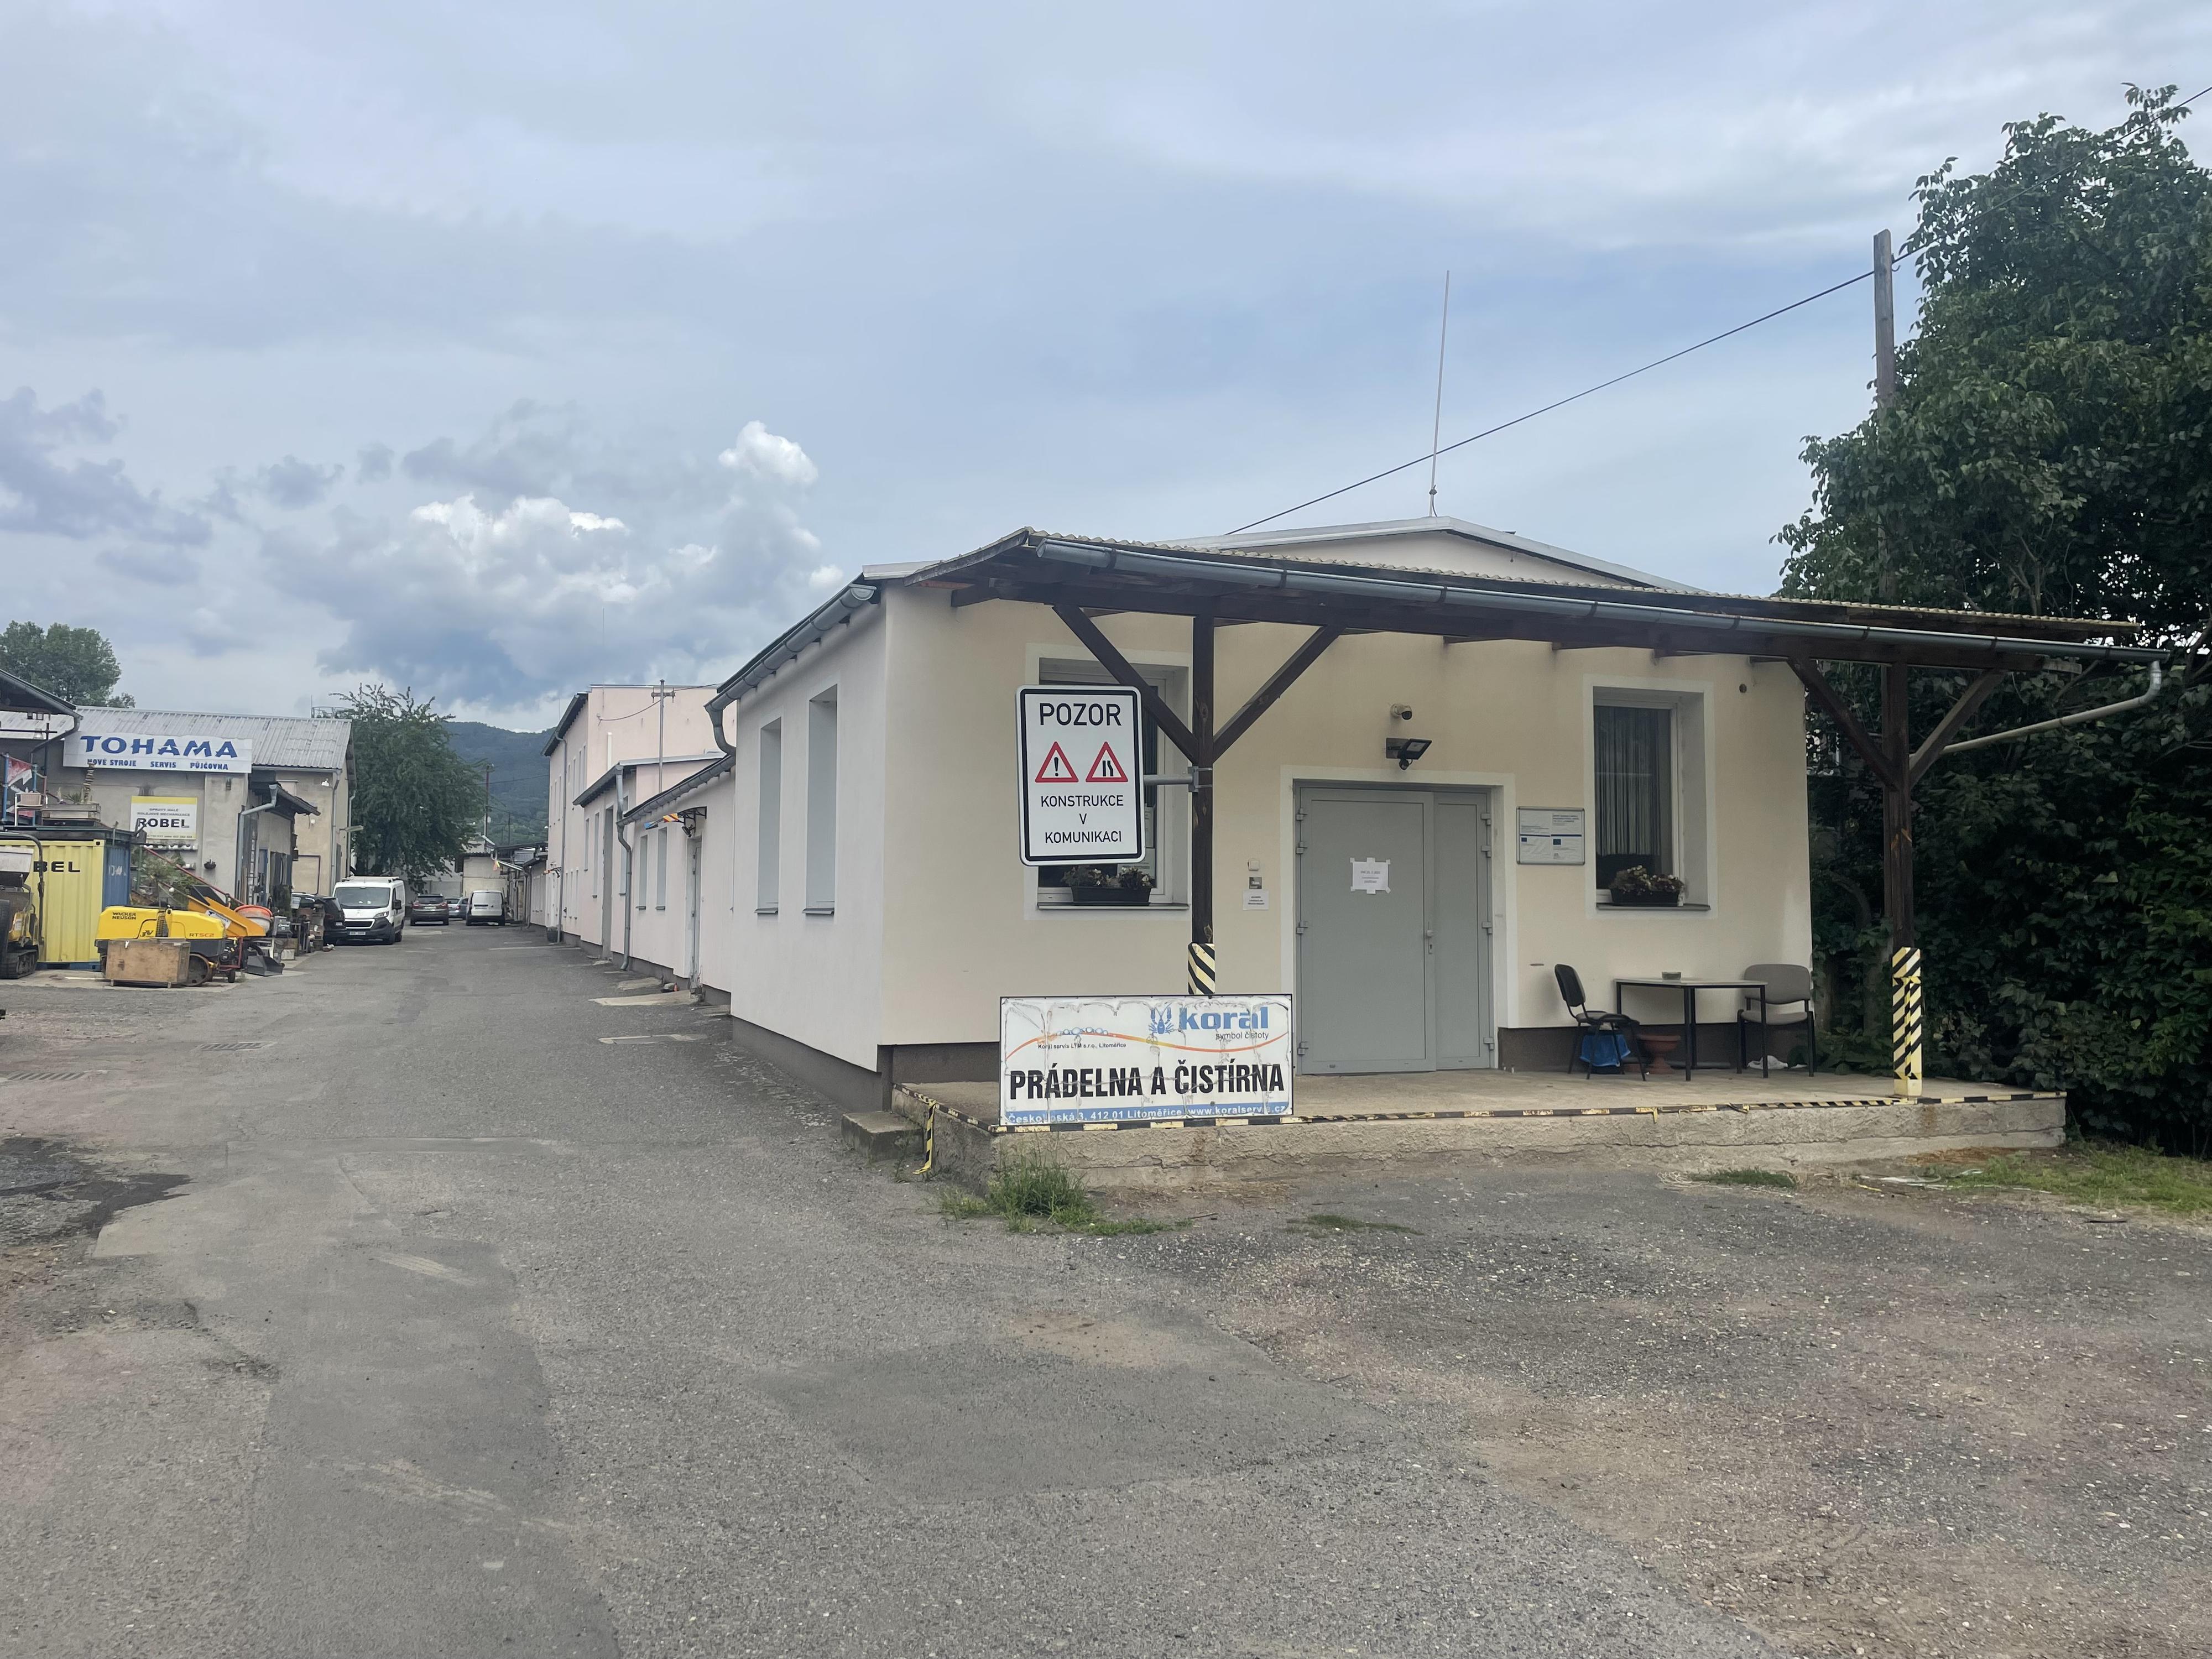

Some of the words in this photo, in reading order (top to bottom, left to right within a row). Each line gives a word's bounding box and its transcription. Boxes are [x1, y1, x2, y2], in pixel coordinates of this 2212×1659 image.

[1039, 703, 1121, 726] POZOR
[80, 735, 238, 758] TOHAMA
[190, 761, 228, 770] PŮJČOVNA
[1041, 795, 1124, 807] KONSTRUKCE
[137, 818, 190, 828] ROBEL
[1079, 813, 1087, 825] V
[1045, 831, 1122, 843] KOMUNIKACI
[1179, 1006, 1269, 1030] koral
[1244, 1031, 1269, 1040] čistoty
[1010, 1062, 1143, 1100] PRÁDELNA
[1151, 1067, 1166, 1095] A
[1175, 1058, 1285, 1094] ČISTÍRNA
[1091, 1111, 1109, 1120] 412
[1112, 1111, 1124, 1119] 01
[1127, 1108, 1182, 1119] Litoměřice
